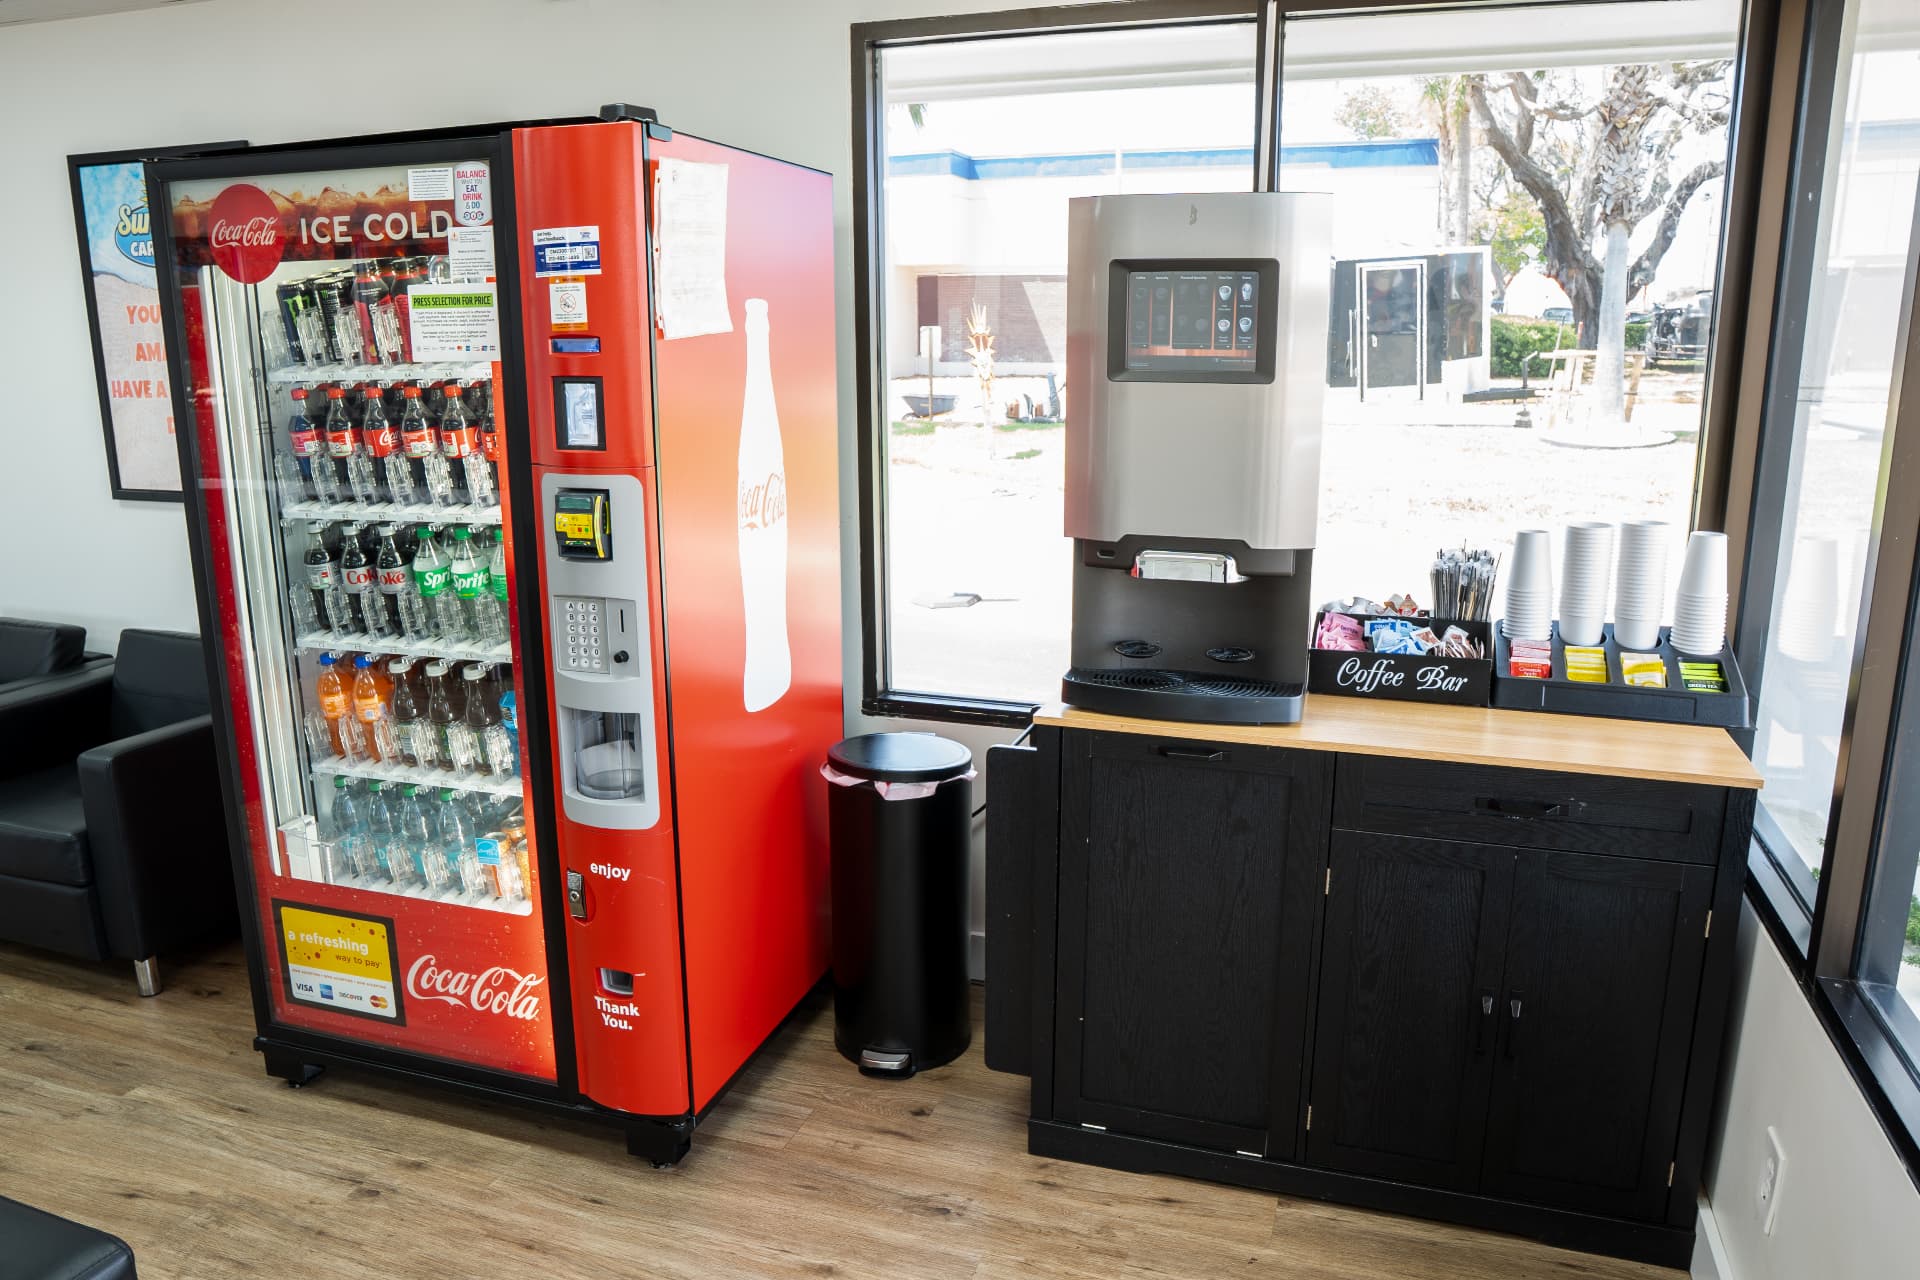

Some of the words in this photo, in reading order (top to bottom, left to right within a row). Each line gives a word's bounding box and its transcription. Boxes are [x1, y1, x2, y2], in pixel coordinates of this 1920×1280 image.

[456, 170, 486, 178] BALANCE
[466, 184, 478, 192] EAT
[212, 216, 278, 248] Coca-Cola
[301, 215, 352, 245] ICE
[363, 210, 453, 242] COLD
[414, 297, 430, 306] PRESS
[432, 296, 460, 306] SELECTION
[462, 296, 473, 304] FOR
[474, 295, 490, 304] PRICE
[111, 380, 152, 398] HAVE
[156, 380, 168, 398] A
[1337, 657, 1405, 693] Coffee
[1416, 665, 1468, 692] Bar
[590, 862, 631, 881] enjoy
[288, 930, 296, 940] a
[300, 932, 368, 956] refreshing
[336, 954, 350, 963] way
[366, 960, 380, 968] pay
[296, 983, 314, 992] VISA
[338, 992, 362, 1000] DISCOVER
[406, 954, 544, 1020] Coca-Cola
[594, 996, 640, 1016] Thank
[602, 1013, 633, 1030] You.
